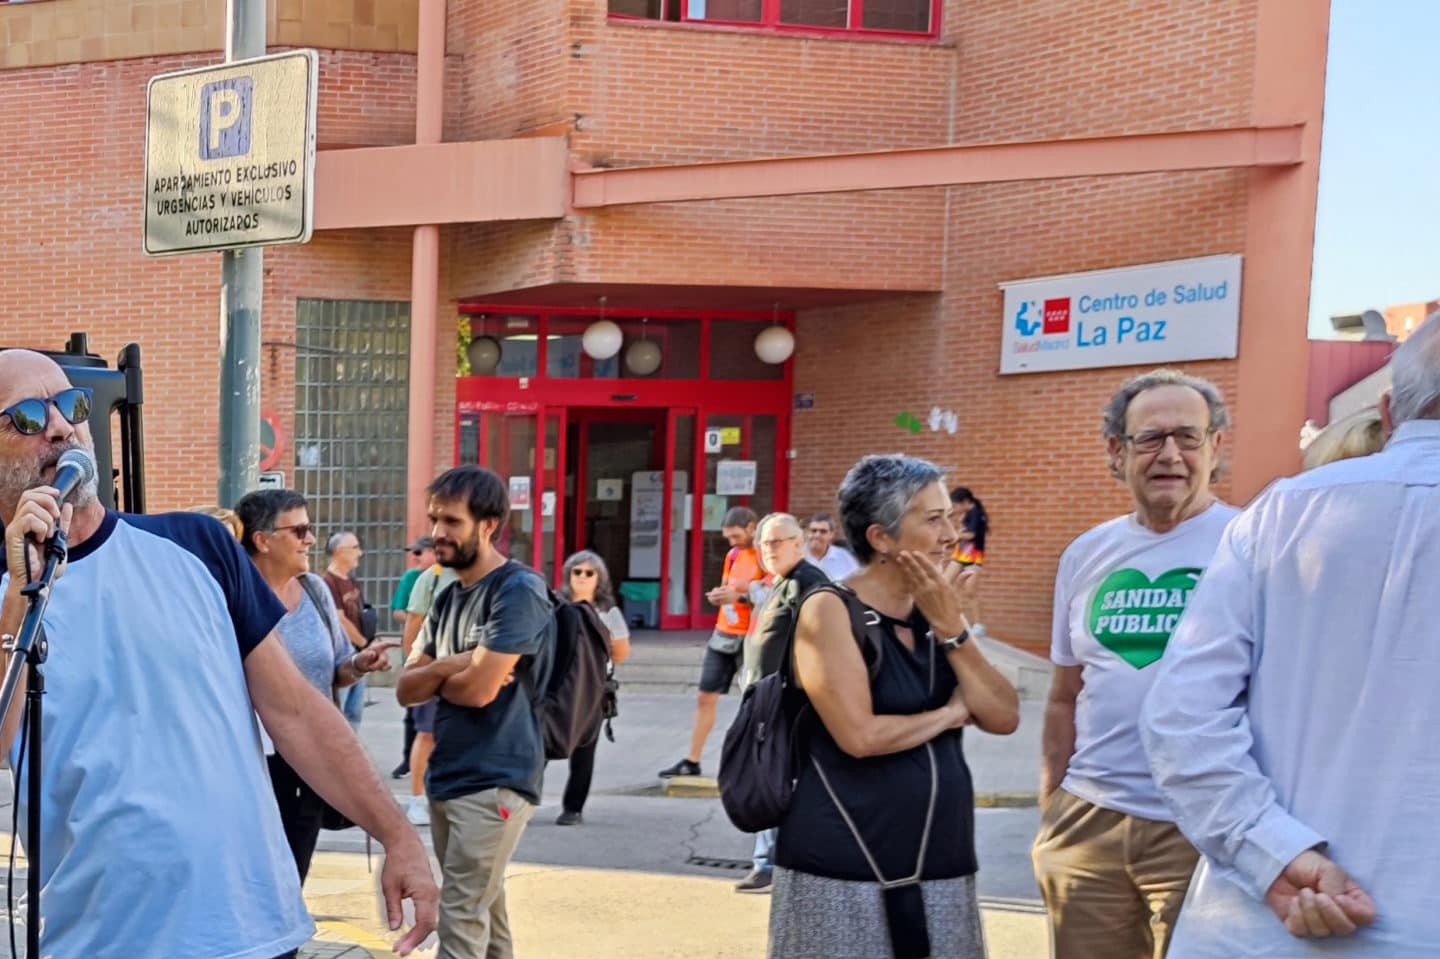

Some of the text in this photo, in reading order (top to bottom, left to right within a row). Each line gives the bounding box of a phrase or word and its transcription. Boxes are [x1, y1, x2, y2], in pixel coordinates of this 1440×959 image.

[210, 88, 241, 149] P
[236, 160, 297, 182] EXCLUSIVO
[157, 194, 215, 215] URGENCIAS
[220, 192, 226, 207] Y
[186, 213, 259, 236] AUTORIZADOS
[1078, 281, 1228, 313] Centro de Salud
[1076, 316, 1167, 347] La Paz
[1101, 588, 1189, 610] SANIDA
[1094, 609, 1179, 634] PÚBLIC
